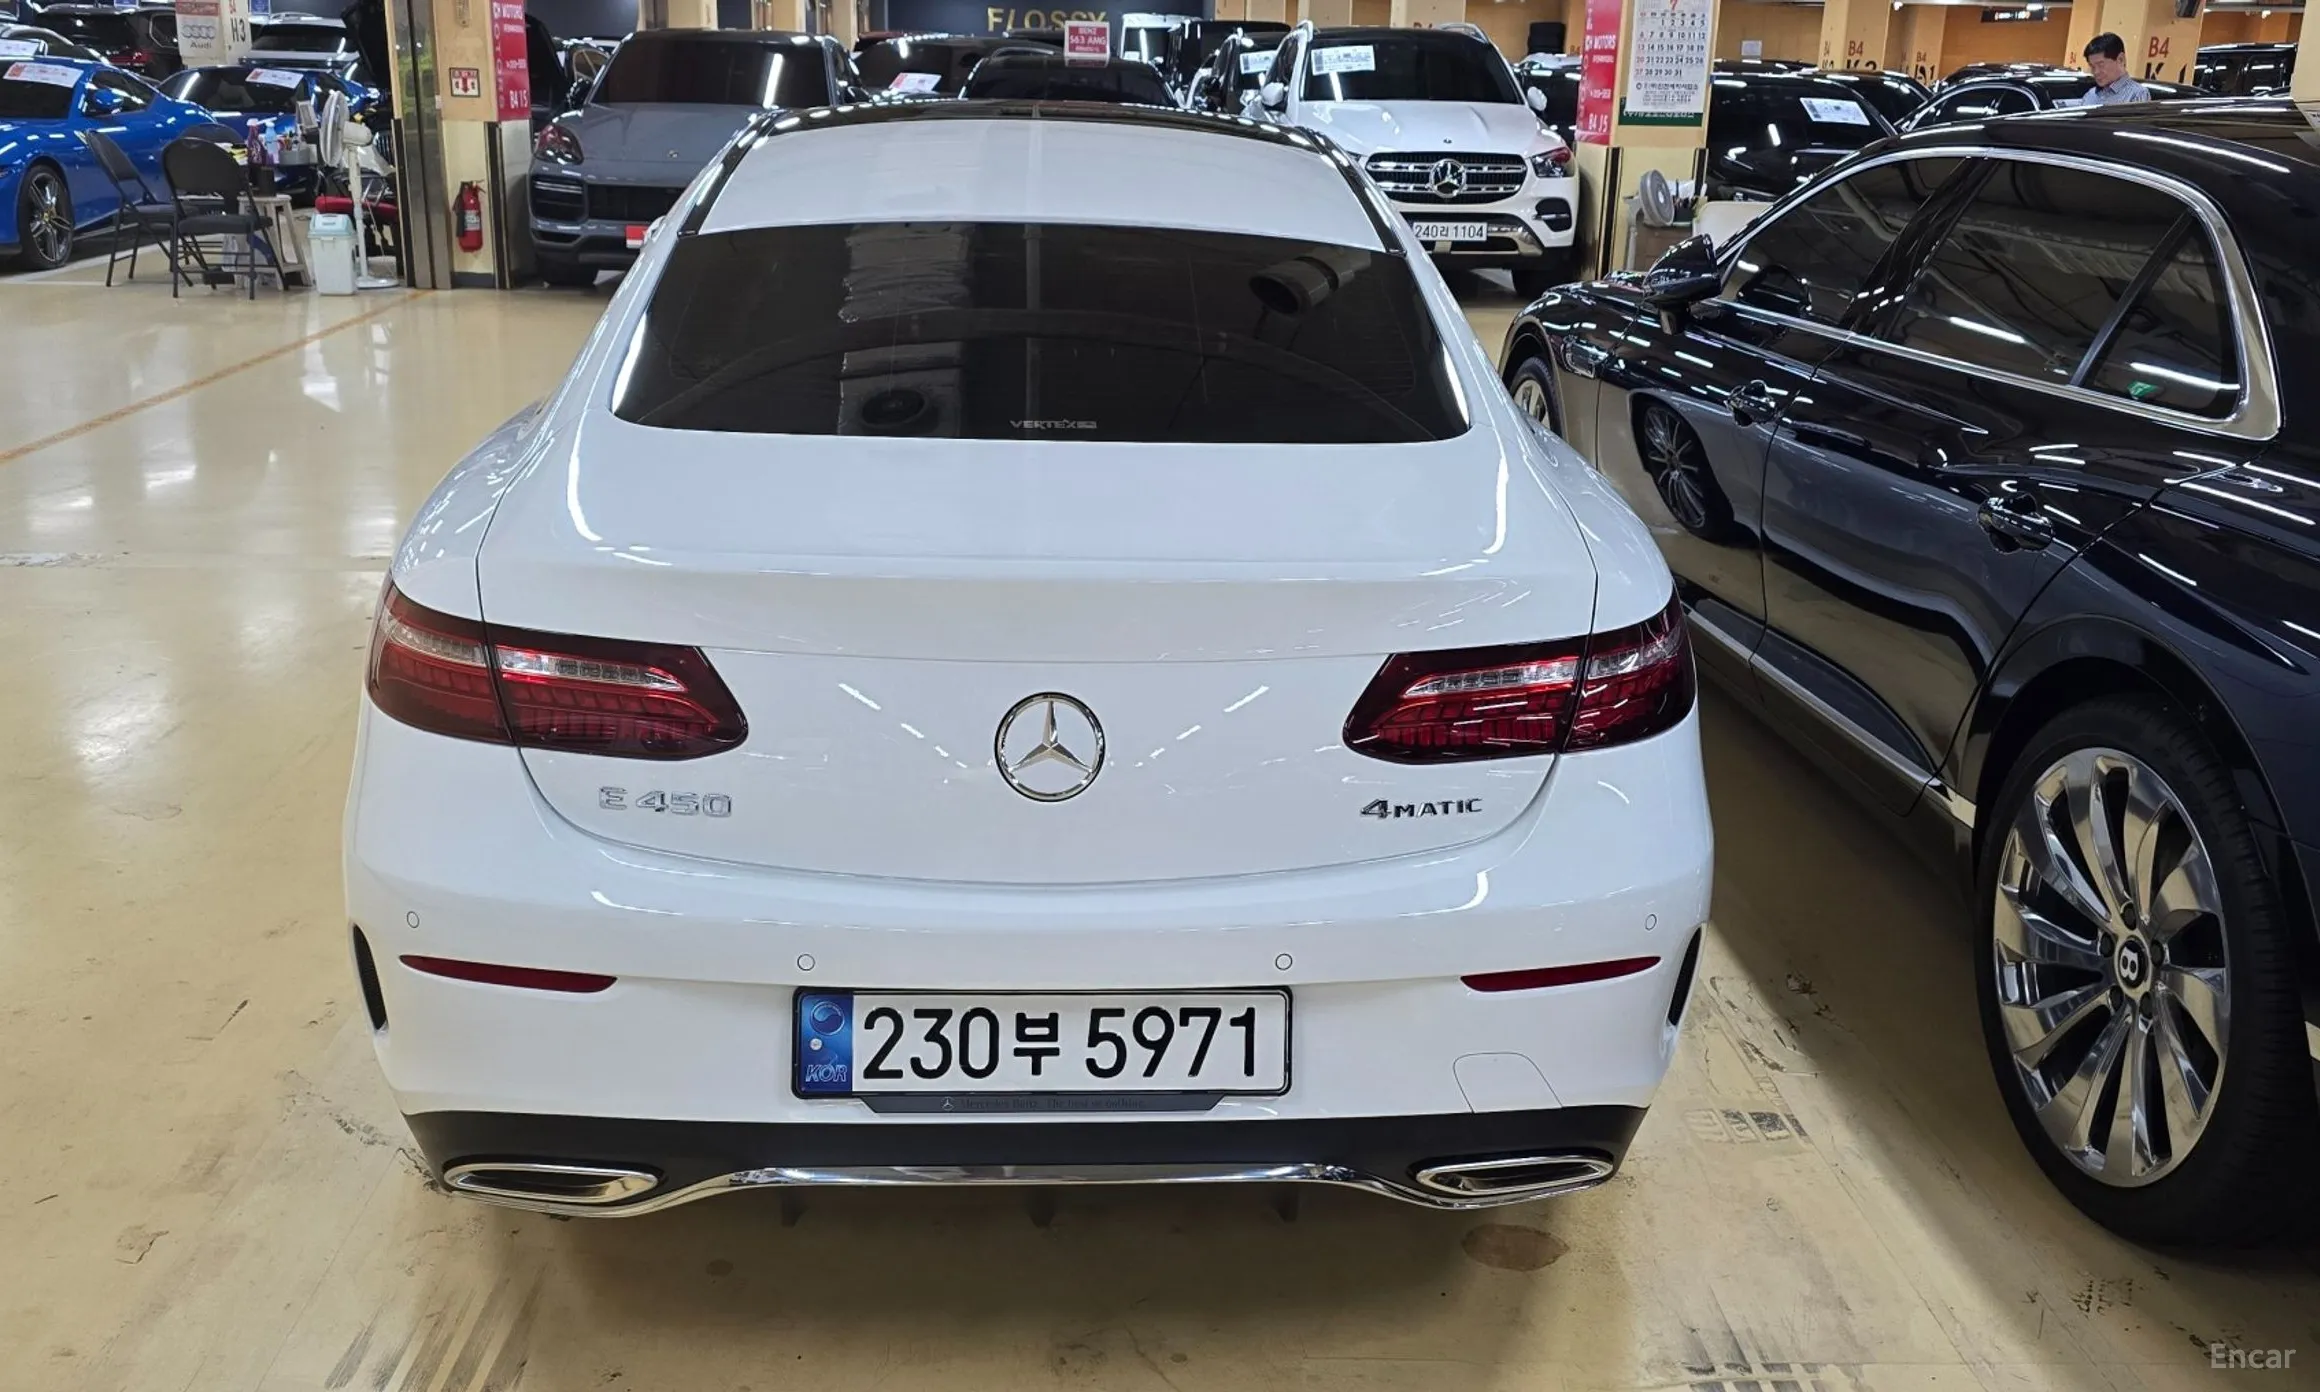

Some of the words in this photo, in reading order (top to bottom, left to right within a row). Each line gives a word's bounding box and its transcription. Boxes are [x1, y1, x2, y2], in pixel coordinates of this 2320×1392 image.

[231, 18, 246, 42] H3
[190, 41, 212, 49] Audi
[1848, 41, 1864, 56] B4
[2149, 37, 2170, 58] B4
[1916, 51, 1927, 62] B4
[1588, 113, 1597, 131] B4
[1453, 225, 1484, 238] 1104
[599, 786, 628, 811] E
[635, 790, 732, 818] 450
[1360, 798, 1483, 819] 4MATIC
[863, 1006, 1061, 1081] 230부
[1085, 1006, 1256, 1078] 5971
[806, 1064, 848, 1083] KOR
